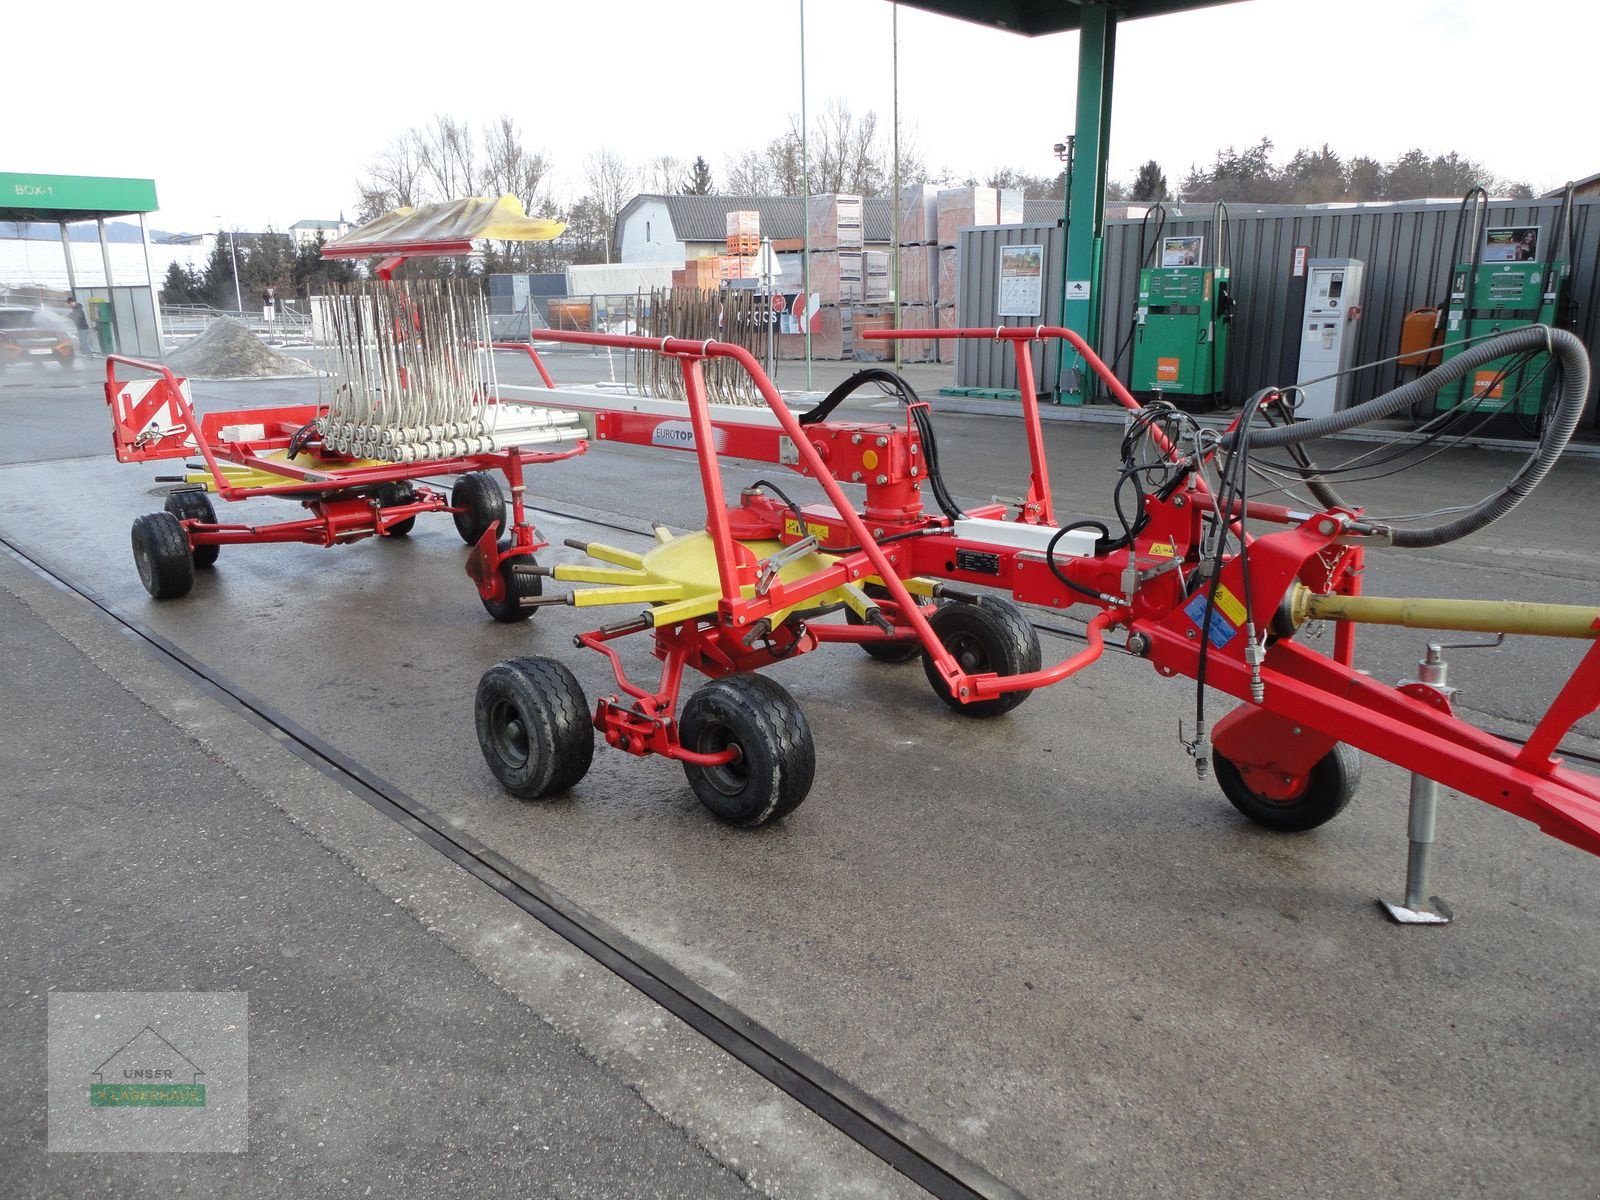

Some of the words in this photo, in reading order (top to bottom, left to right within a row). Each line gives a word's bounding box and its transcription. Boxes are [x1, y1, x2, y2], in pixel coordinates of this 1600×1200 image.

[15, 184, 53, 196] BOX-1
[1138, 328, 1144, 344] 1
[1198, 328, 1207, 344] 2
[656, 428, 693, 441] EUROTOP
